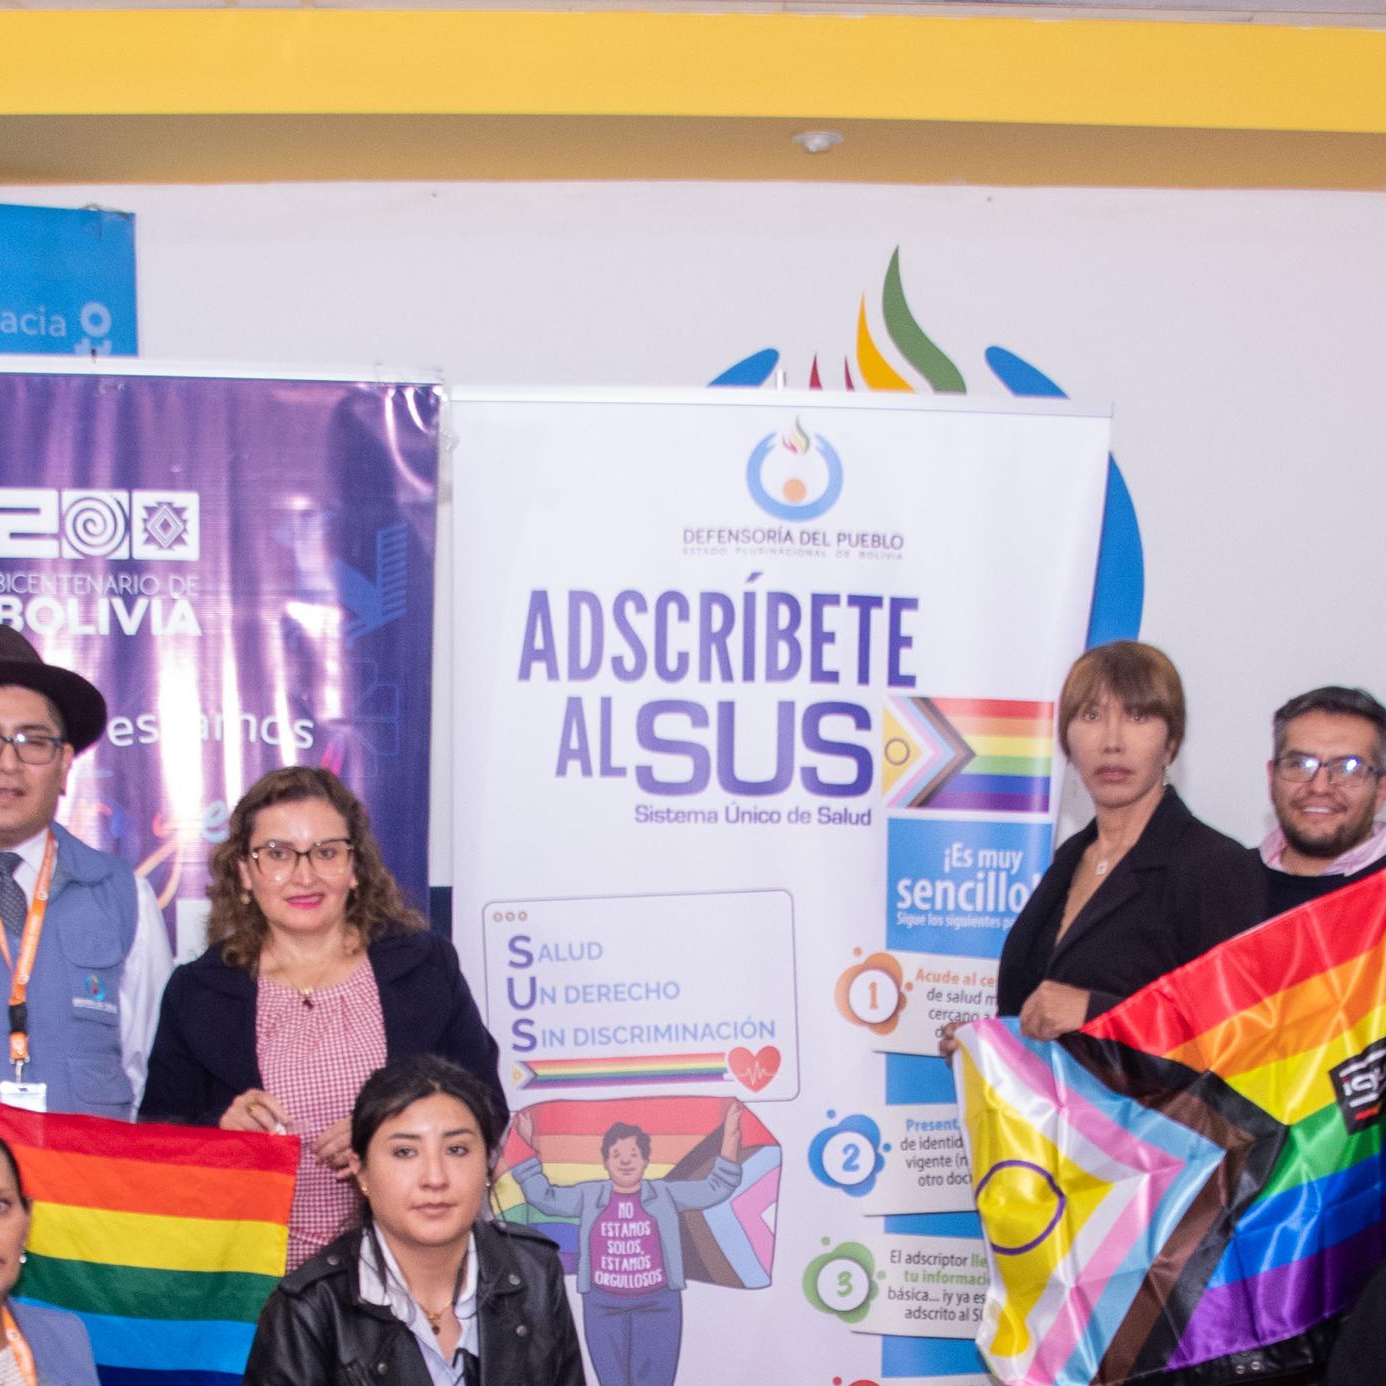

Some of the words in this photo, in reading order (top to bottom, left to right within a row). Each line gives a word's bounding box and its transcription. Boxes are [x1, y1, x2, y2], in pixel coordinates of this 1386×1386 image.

[683, 527, 794, 545] DEFENSORÍA
[800, 531, 830, 547] DEL
[837, 532, 904, 550] PUEBLO
[169, 574, 200, 596] DE
[518, 571, 919, 689] ADSCRÍBETE
[555, 696, 627, 779] AL
[635, 698, 875, 799] SUS
[635, 804, 718, 824] Sistema
[725, 802, 781, 824] Único
[787, 806, 811, 824] de
[817, 806, 872, 826] Salud
[944, 842, 973, 873] ¡Es
[978, 848, 1024, 875] muy
[897, 912, 926, 929] Sigue
[928, 913, 943, 926] los
[946, 914, 1001, 931] siguientes
[507, 935, 603, 970] SALUD
[916, 968, 959, 985] Acude
[963, 971, 977, 985] al
[507, 976, 557, 1011] UN
[564, 980, 681, 1005] DERECHO
[868, 982, 879, 1009] 1
[927, 988, 943, 1002] de
[946, 990, 982, 1005] salud
[511, 1018, 565, 1053] SIN
[573, 1015, 776, 1048] DISCRIMINACIÓN
[906, 1118, 959, 1132] Present
[900, 1137, 916, 1151] de
[919, 1137, 964, 1150] identid
[842, 1143, 860, 1173] 2
[906, 1155, 953, 1172] vigente
[918, 1174, 944, 1187] otro
[618, 1202, 634, 1219] NO
[601, 1221, 651, 1237] ESTAMOS
[601, 1255, 651, 1270] ESTAMOS
[890, 1250, 901, 1264] El
[905, 1252, 968, 1268] adscriptor
[595, 1269, 663, 1288] ORGULLOSOS
[837, 1271, 853, 1297] 3
[904, 1270, 918, 1283] tu
[922, 1271, 990, 1286] informaci
[956, 1294, 970, 1306] ya
[905, 1306, 956, 1321] adscrito
[958, 1308, 970, 1321] al
